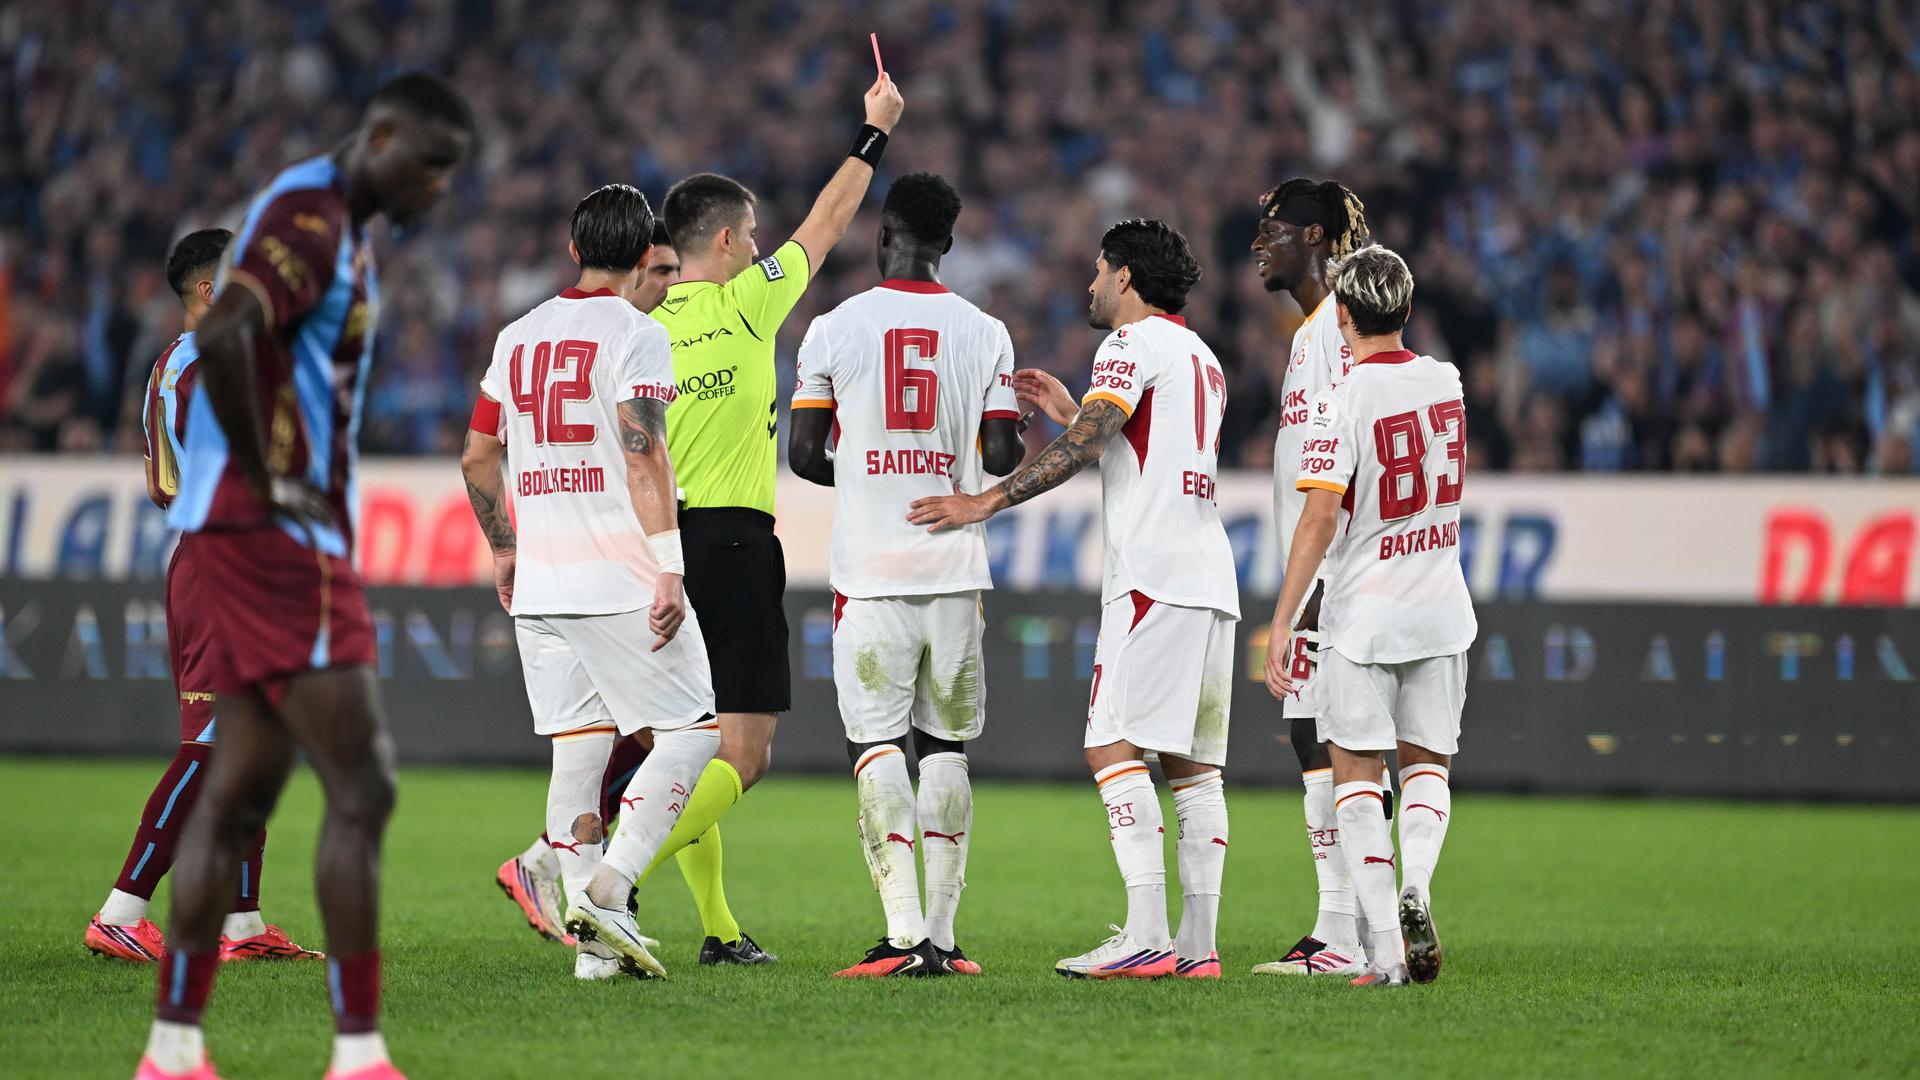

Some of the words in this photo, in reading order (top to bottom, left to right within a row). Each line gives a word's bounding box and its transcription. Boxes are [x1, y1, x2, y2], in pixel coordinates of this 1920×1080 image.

[509, 339, 598, 447] 42
[697, 385, 736, 401] COFFEE
[884, 328, 941, 435] 6
[866, 449, 957, 479] SANCHEZ
[1373, 398, 1467, 523] 83
